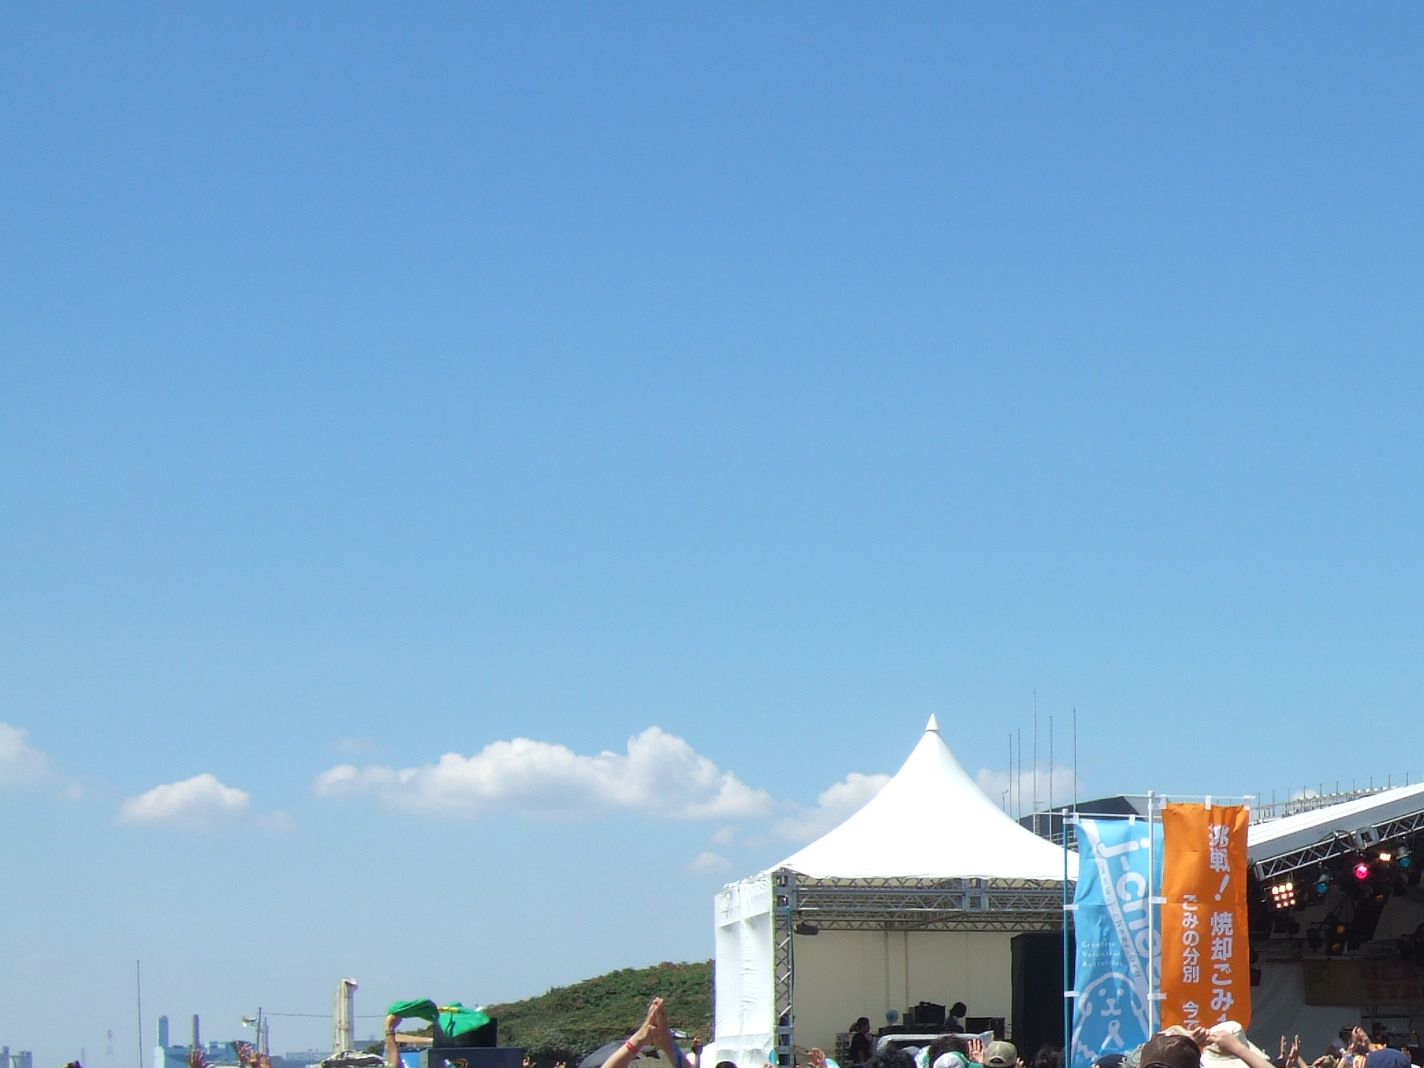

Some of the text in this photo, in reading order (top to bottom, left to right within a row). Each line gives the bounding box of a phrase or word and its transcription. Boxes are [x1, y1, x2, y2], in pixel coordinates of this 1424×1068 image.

[1208, 824, 1231, 901] 挑戦！
[1182, 894, 1200, 983] ごみの分別
